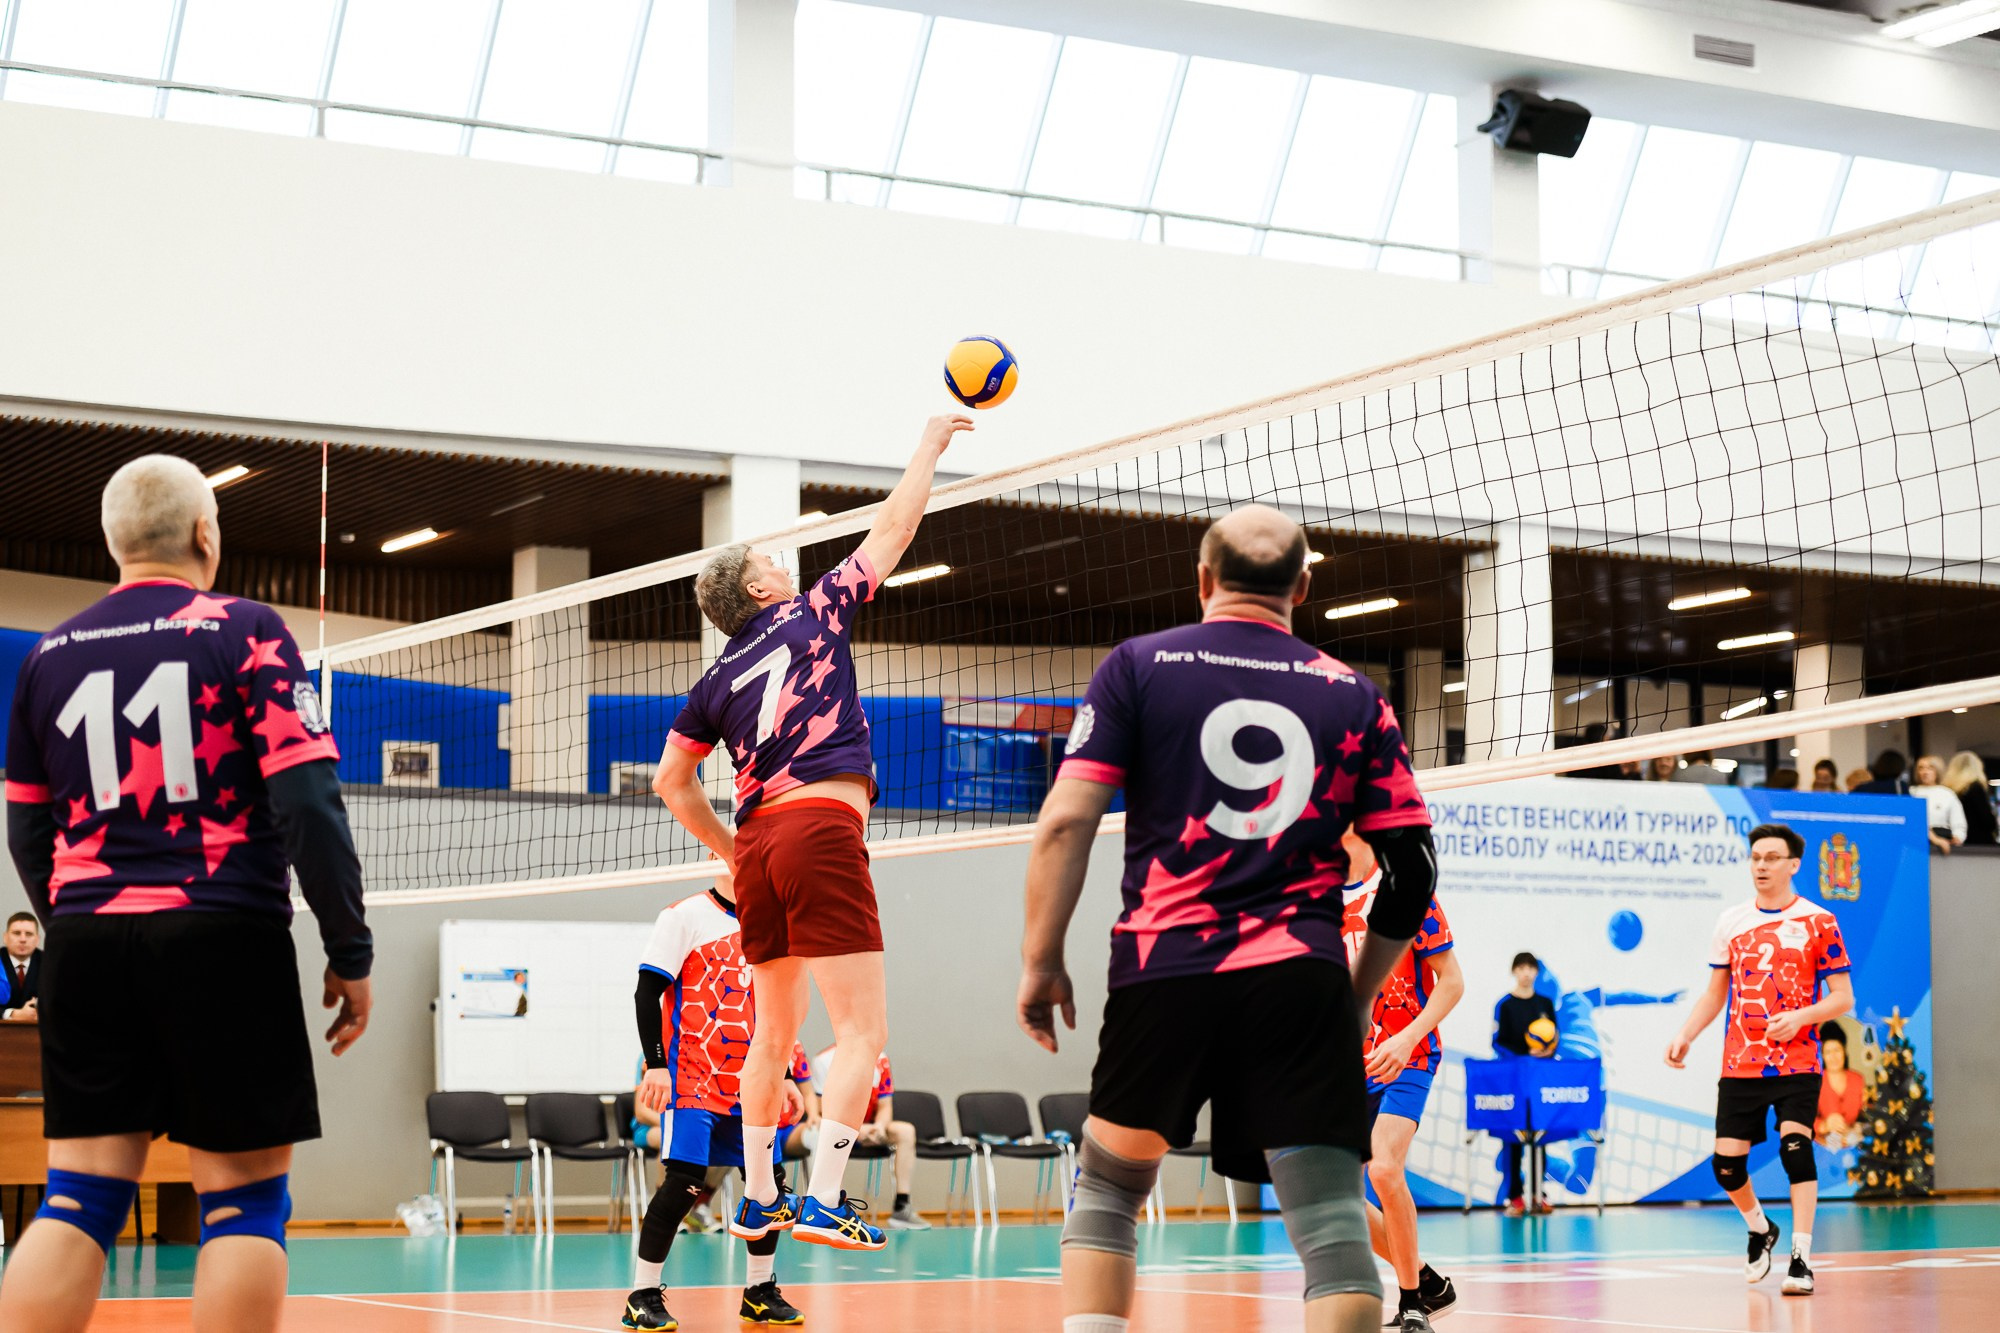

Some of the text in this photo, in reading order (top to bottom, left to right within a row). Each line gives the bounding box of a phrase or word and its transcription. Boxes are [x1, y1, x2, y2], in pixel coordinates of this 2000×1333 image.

[71, 622, 151, 642] Чемпионов
[154, 617, 220, 631] Бизнеса
[721, 632, 767, 664] Чемпионов
[767, 610, 803, 635] Бизнеса
[1154, 650, 1357, 685] Лига Чемпионов Бизнеса
[730, 643, 791, 747] 7
[55, 661, 199, 811] 11
[1200, 698, 1316, 840] 9
[1428, 802, 1628, 831] ОЖДЕСТВЕНСКИЙ
[1635, 812, 1718, 834] ТУРНИР
[1726, 814, 1751, 837] ПО
[1433, 829, 1549, 858] ОЛЕЙБОЛУ
[1757, 943, 1774, 970] 2
